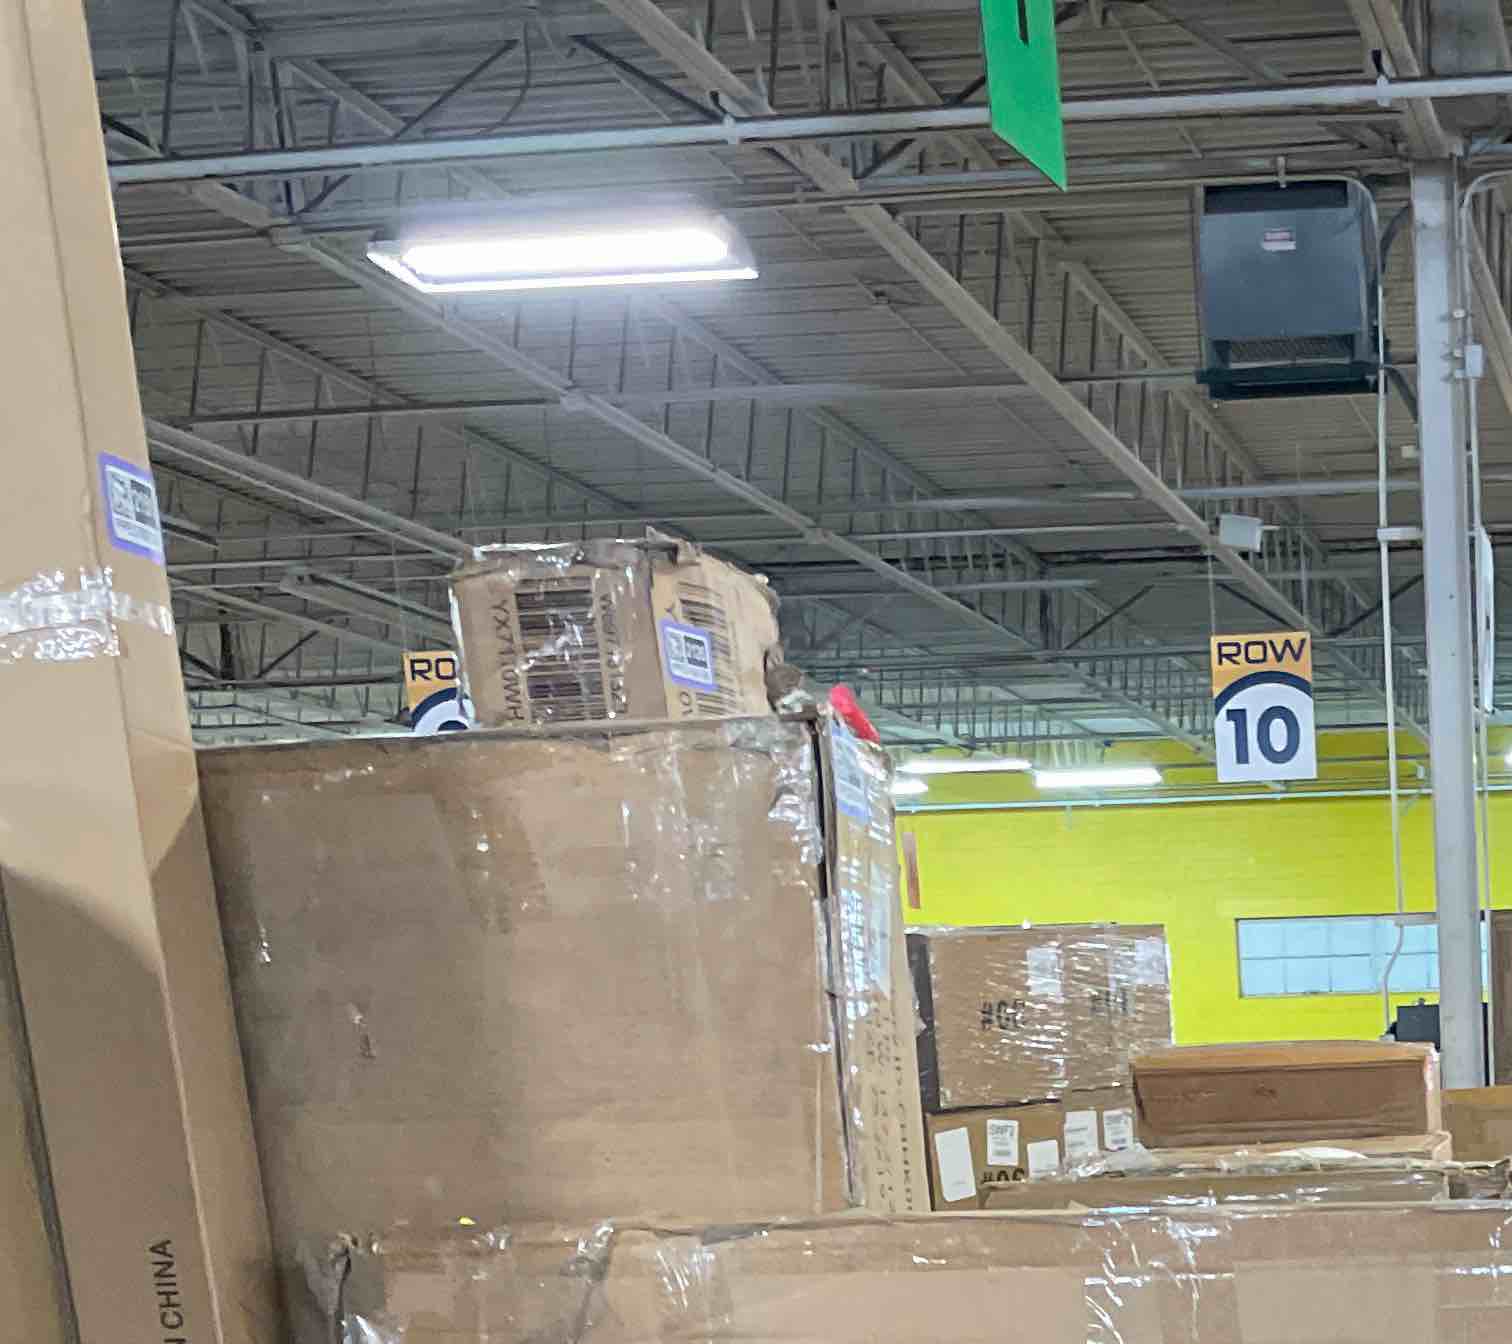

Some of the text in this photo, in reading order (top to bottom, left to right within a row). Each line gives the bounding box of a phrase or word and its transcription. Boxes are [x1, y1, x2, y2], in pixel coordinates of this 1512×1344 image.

[410, 657, 457, 681] RO
[1217, 639, 1306, 665] ROW
[1226, 705, 1300, 764] 10
[150, 1239, 184, 1330] CHINA
